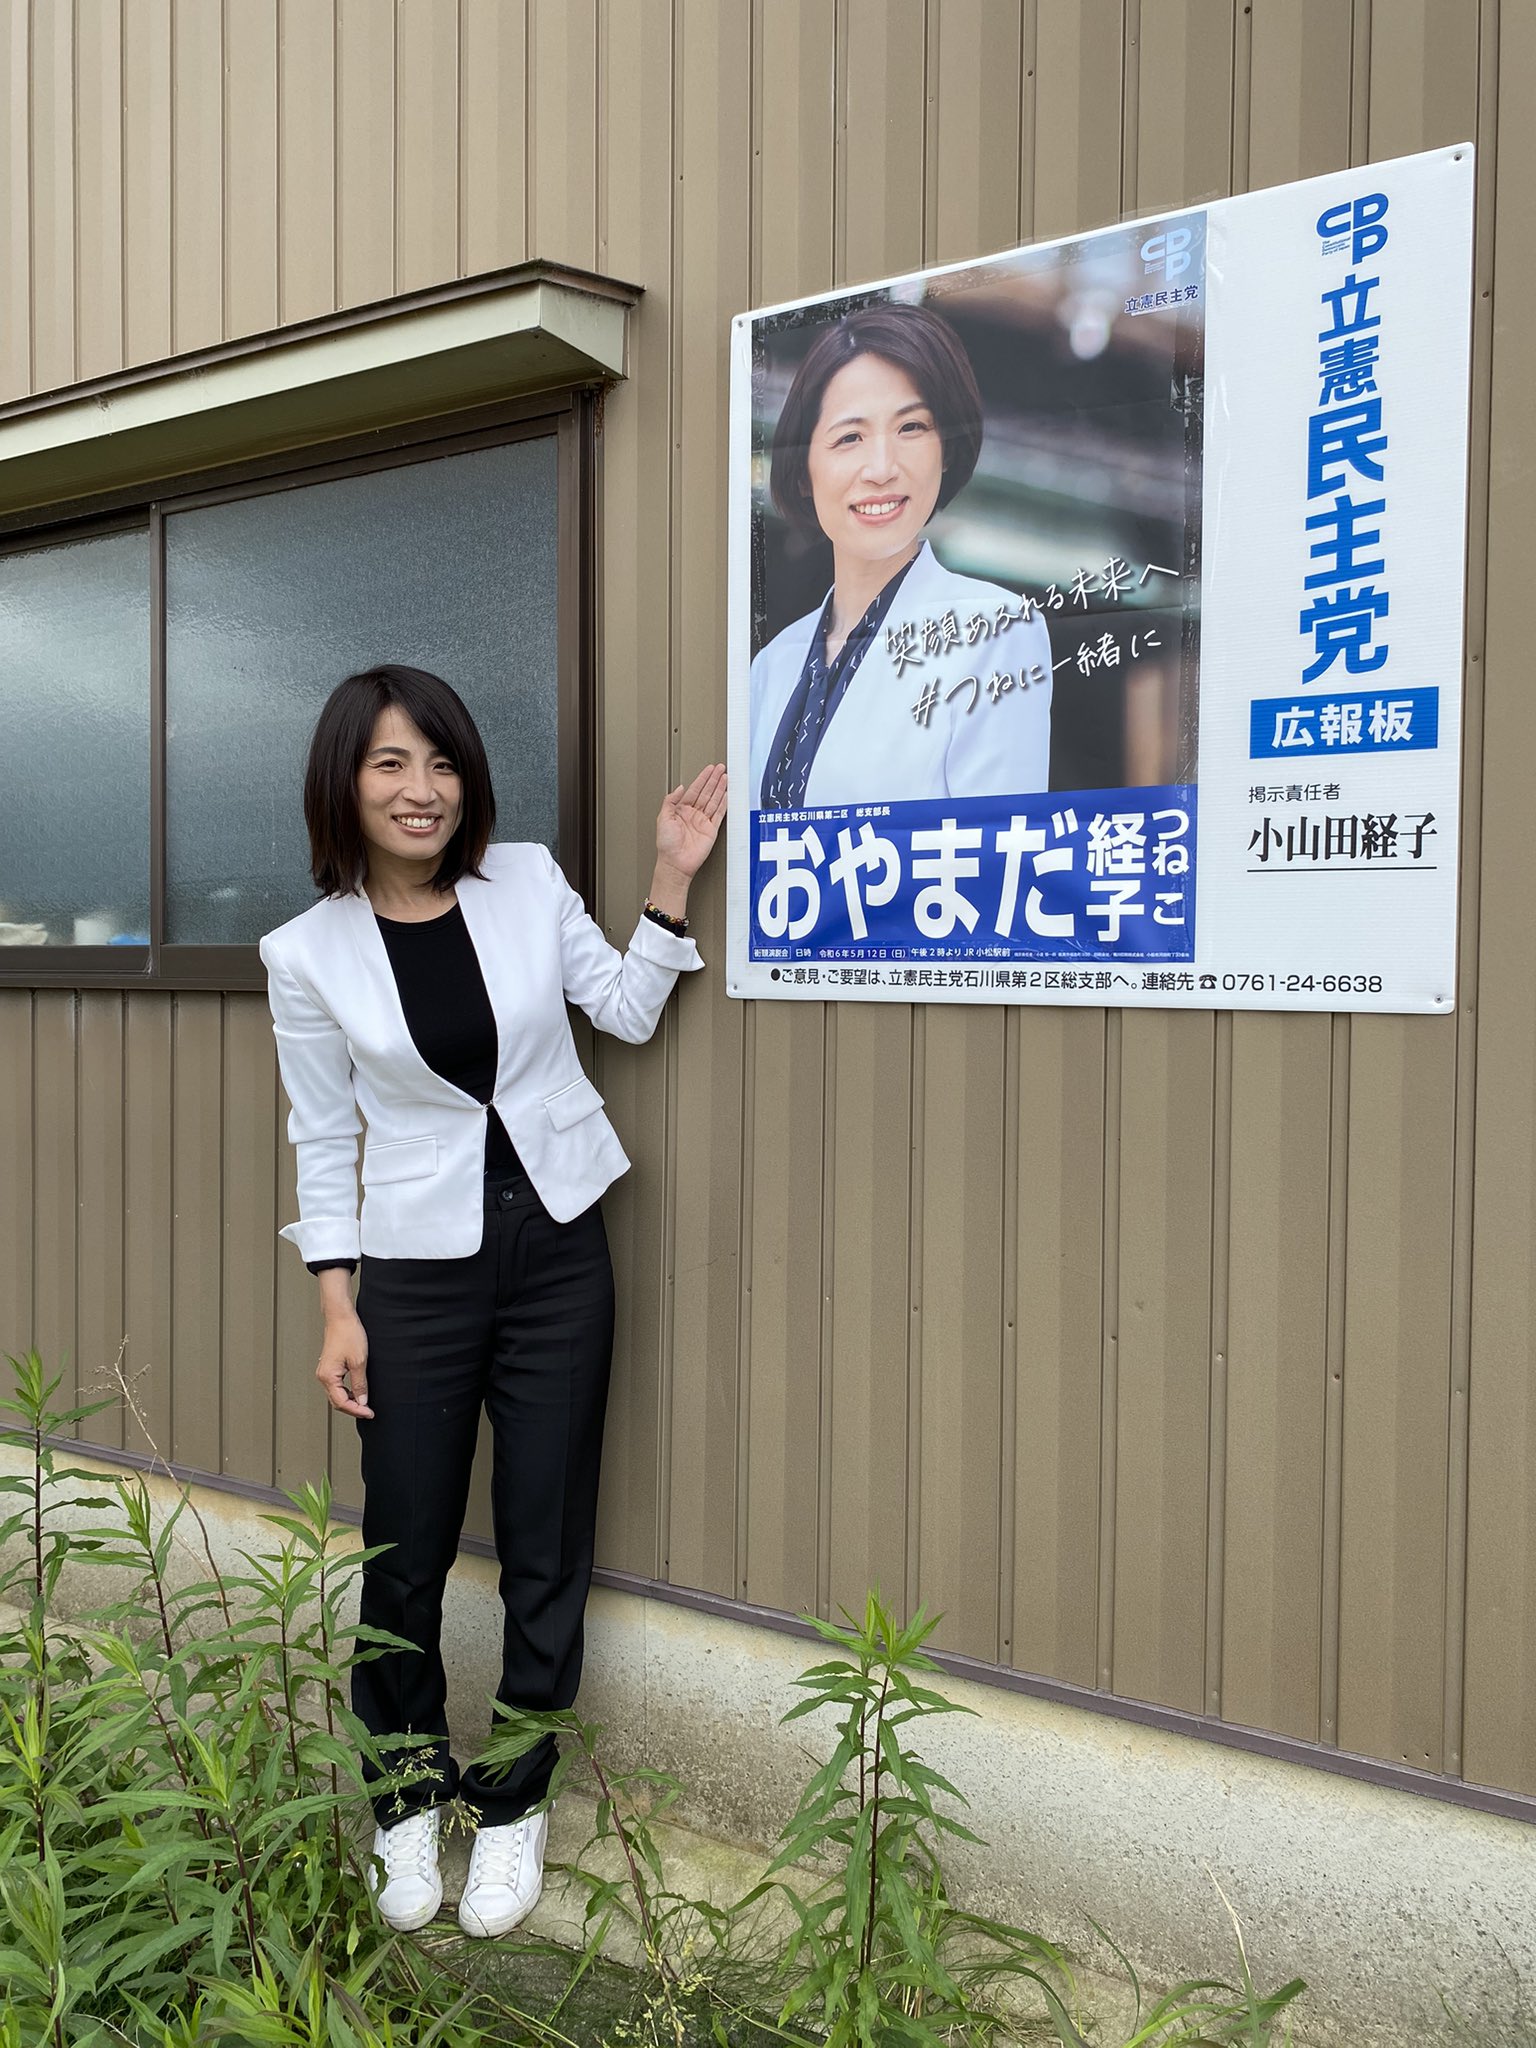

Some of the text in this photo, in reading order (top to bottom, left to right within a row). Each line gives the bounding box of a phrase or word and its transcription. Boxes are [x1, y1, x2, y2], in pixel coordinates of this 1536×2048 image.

[1125, 284, 1199, 313] 立憲民主党
[1299, 273, 1389, 686] 立憲民主党
[885, 556, 1180, 677] 笑顔あふれる未来へ
[911, 629, 1162, 727] #つねに一緒に
[1271, 699, 1414, 749] 広報板
[758, 806, 891, 824] 立憲民主党石川県第二区 総支部長
[1248, 783, 1341, 804] 掲示責任者
[757, 807, 1078, 942] おやまだ
[1152, 808, 1190, 926] つねこ
[1247, 812, 1438, 863] 小山田経子
[1086, 812, 1148, 942] 経子
[1221, 974, 1385, 994] 0761-24-6638
